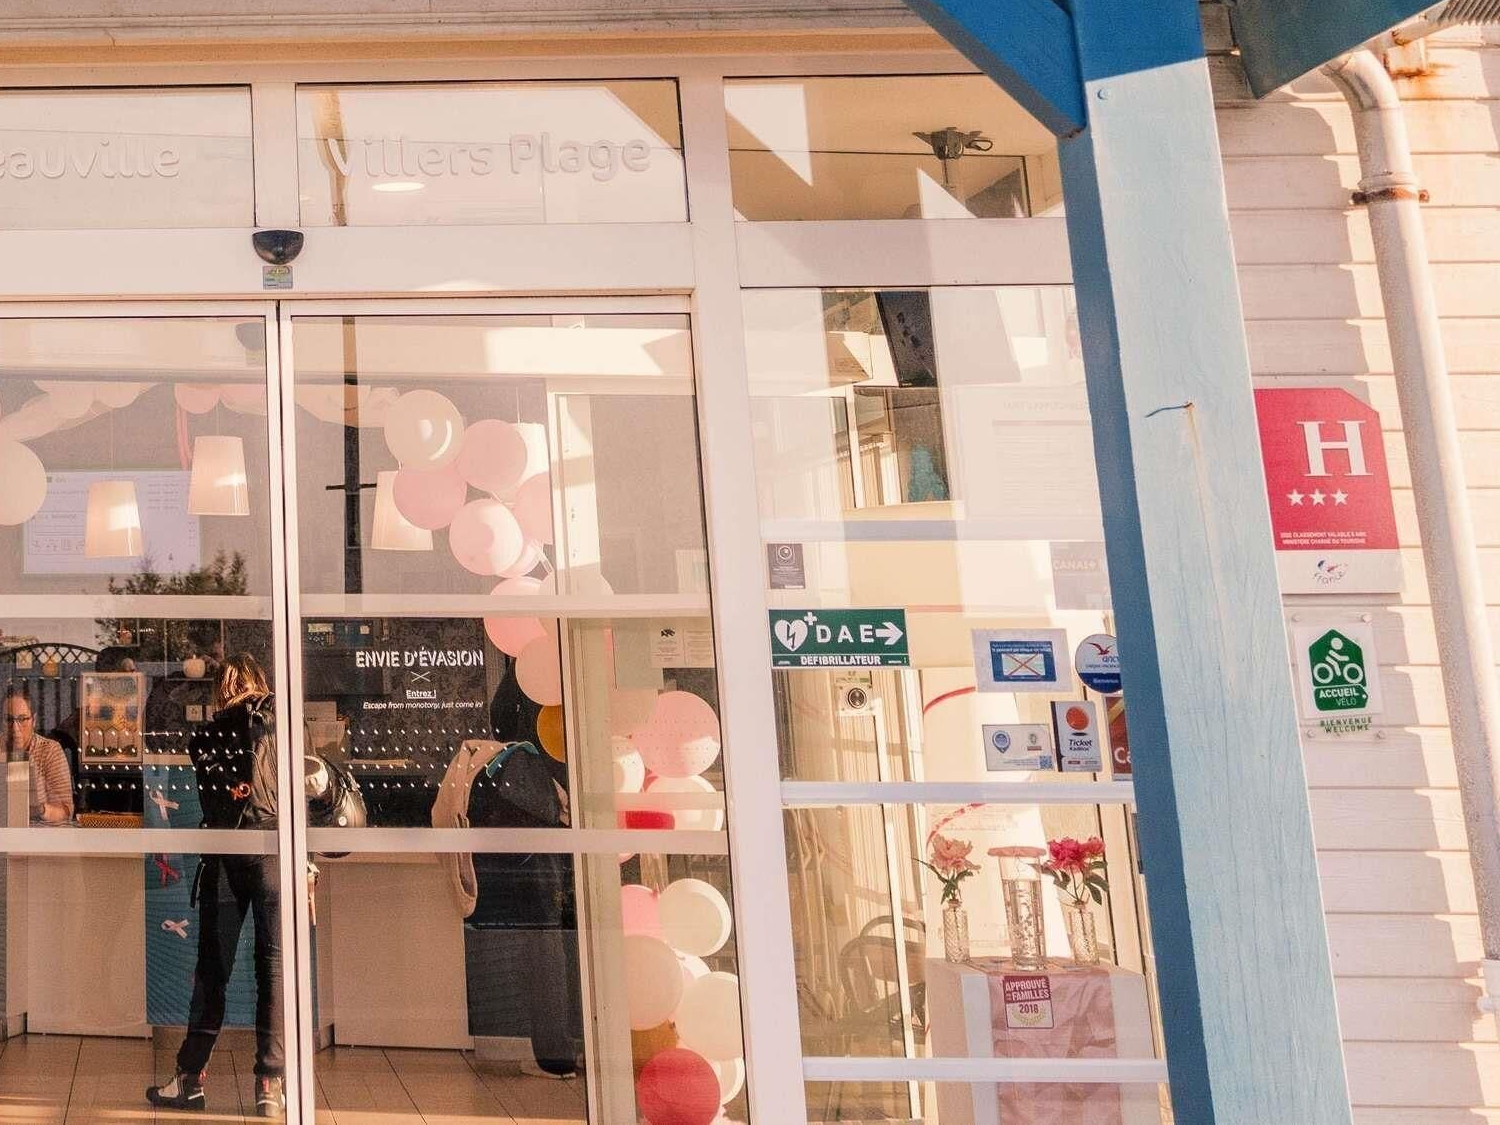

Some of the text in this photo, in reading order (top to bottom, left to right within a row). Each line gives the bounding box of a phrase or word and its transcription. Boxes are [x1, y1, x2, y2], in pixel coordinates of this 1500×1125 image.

[509, 132, 651, 183] Plage
[1296, 420, 1374, 476] H
[355, 646, 484, 667] ENVIE D'ÉVASION
[406, 690, 432, 699] Entrez
[1319, 687, 1360, 699] ACCUEIL
[363, 702, 387, 710] Escape
[388, 701, 405, 709] from
[441, 702, 455, 710] just
[1320, 716, 1372, 727] BIENVENUE
[1325, 724, 1369, 734] WELCOME
[1068, 738, 1092, 746] Ticket
[1005, 976, 1048, 992] APPROUVÉ
[1011, 989, 1050, 1001] FAMILLES
